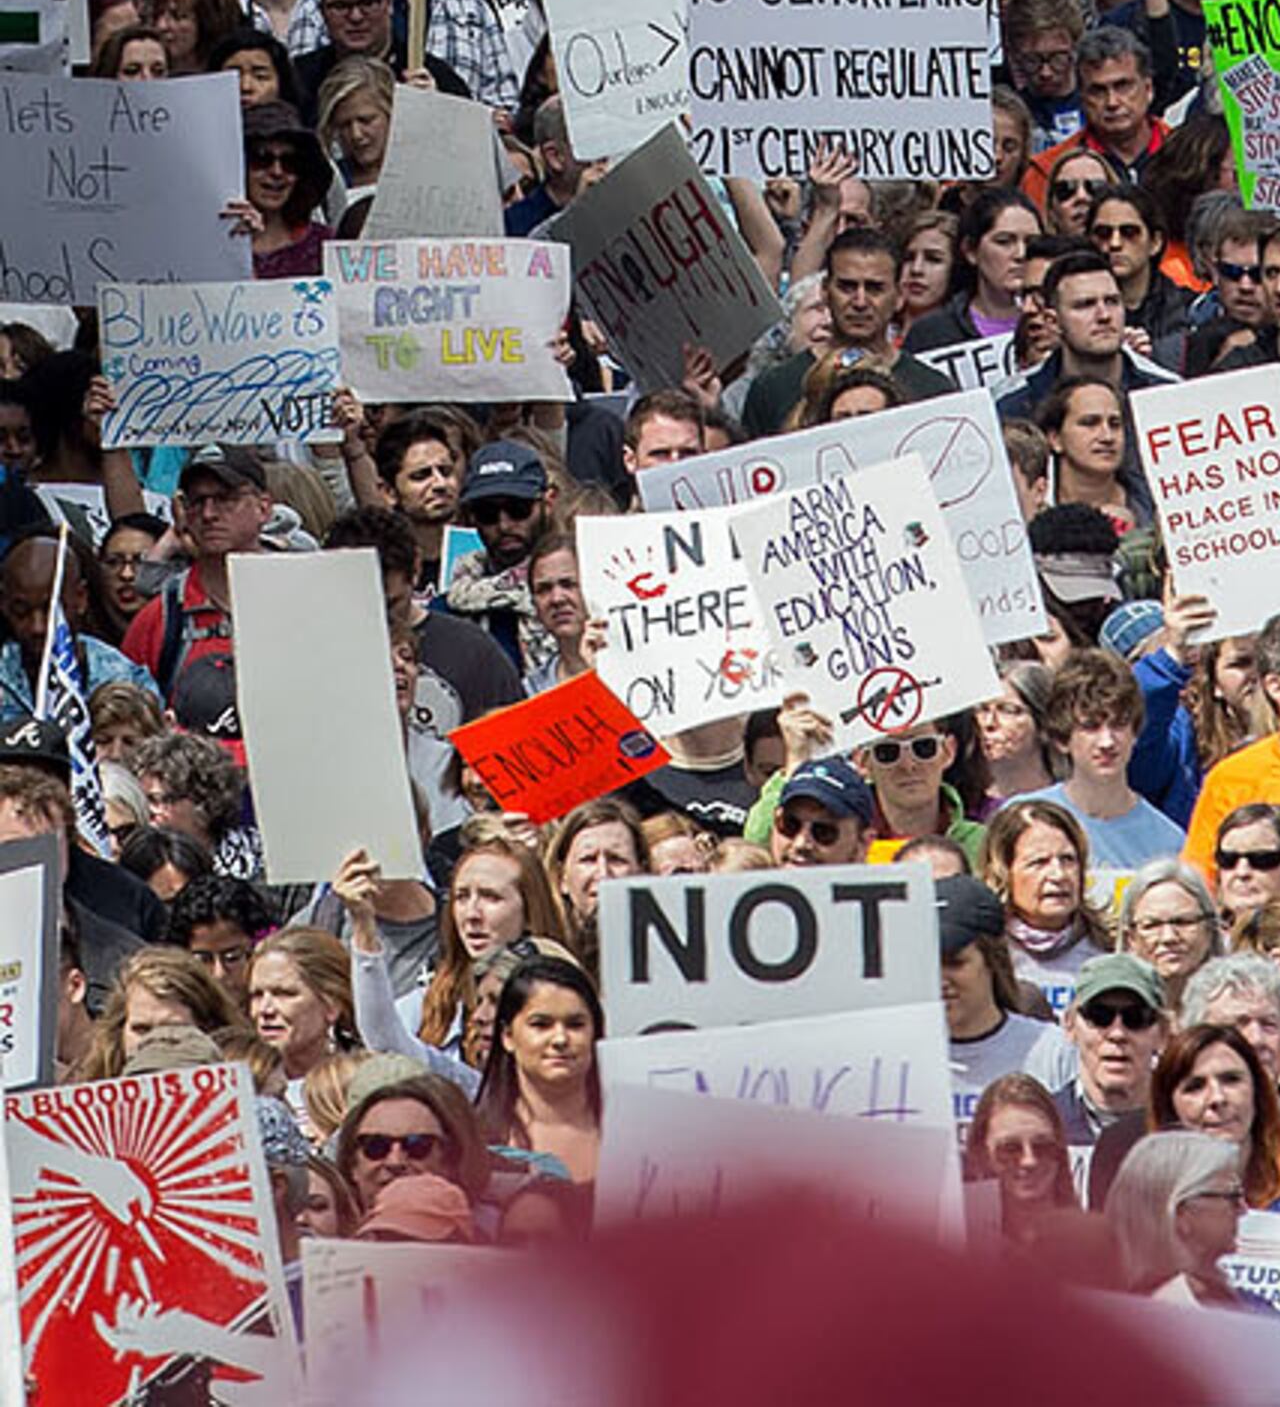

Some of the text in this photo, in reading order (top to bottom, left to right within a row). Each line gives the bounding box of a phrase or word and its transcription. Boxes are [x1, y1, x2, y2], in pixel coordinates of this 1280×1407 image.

[690, 46, 991, 102] CANNOT REGULATE
[46, 148, 128, 201] Not
[373, 285, 481, 328] RIGHT
[1146, 404, 1277, 465] FEAR
[789, 480, 851, 526] ARM
[1158, 459, 1226, 501] HAS
[761, 511, 886, 577] AMERICA
[609, 586, 755, 653] THERE
[827, 628, 918, 683] GUNS
[474, 704, 622, 805] ENOUGH
[629, 881, 908, 985] NOT
[32, 1066, 240, 1120] BLOOD IS ON
